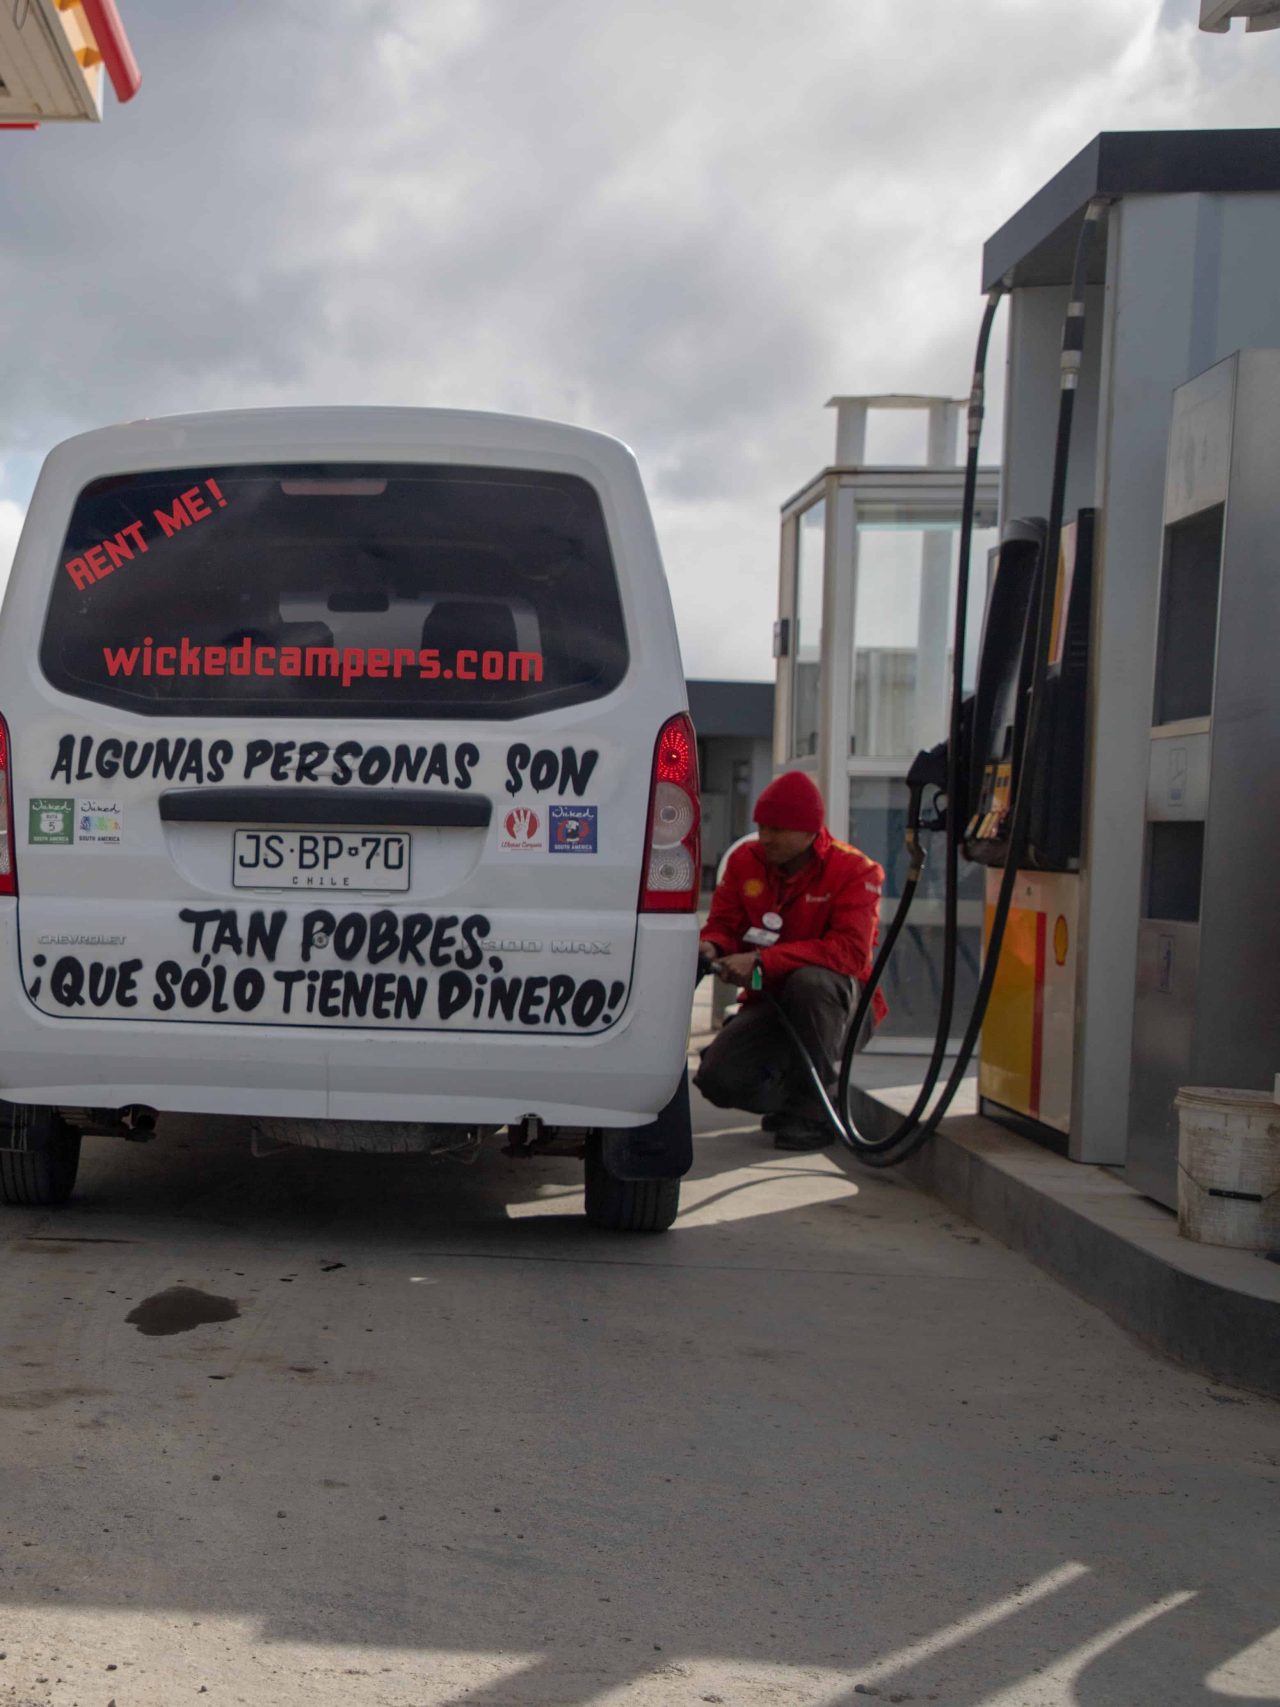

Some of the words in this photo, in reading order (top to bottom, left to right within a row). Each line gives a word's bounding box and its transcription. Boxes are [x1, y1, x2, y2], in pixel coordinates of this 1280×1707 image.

[65, 520, 149, 591] RENT
[153, 478, 228, 538] ME!
[103, 638, 544, 687] wickedcampers.com
[50, 734, 233, 784] ALGUNAS
[243, 739, 480, 789] PERSONAS
[505, 743, 599, 797] SON
[48, 821, 56, 832] 5
[292, 876, 350, 886] CHILE
[38, 935, 127, 945] CHEVROLET
[179, 908, 287, 962] TAN
[301, 910, 503, 973] POBRES,
[551, 940, 612, 955] MAX
